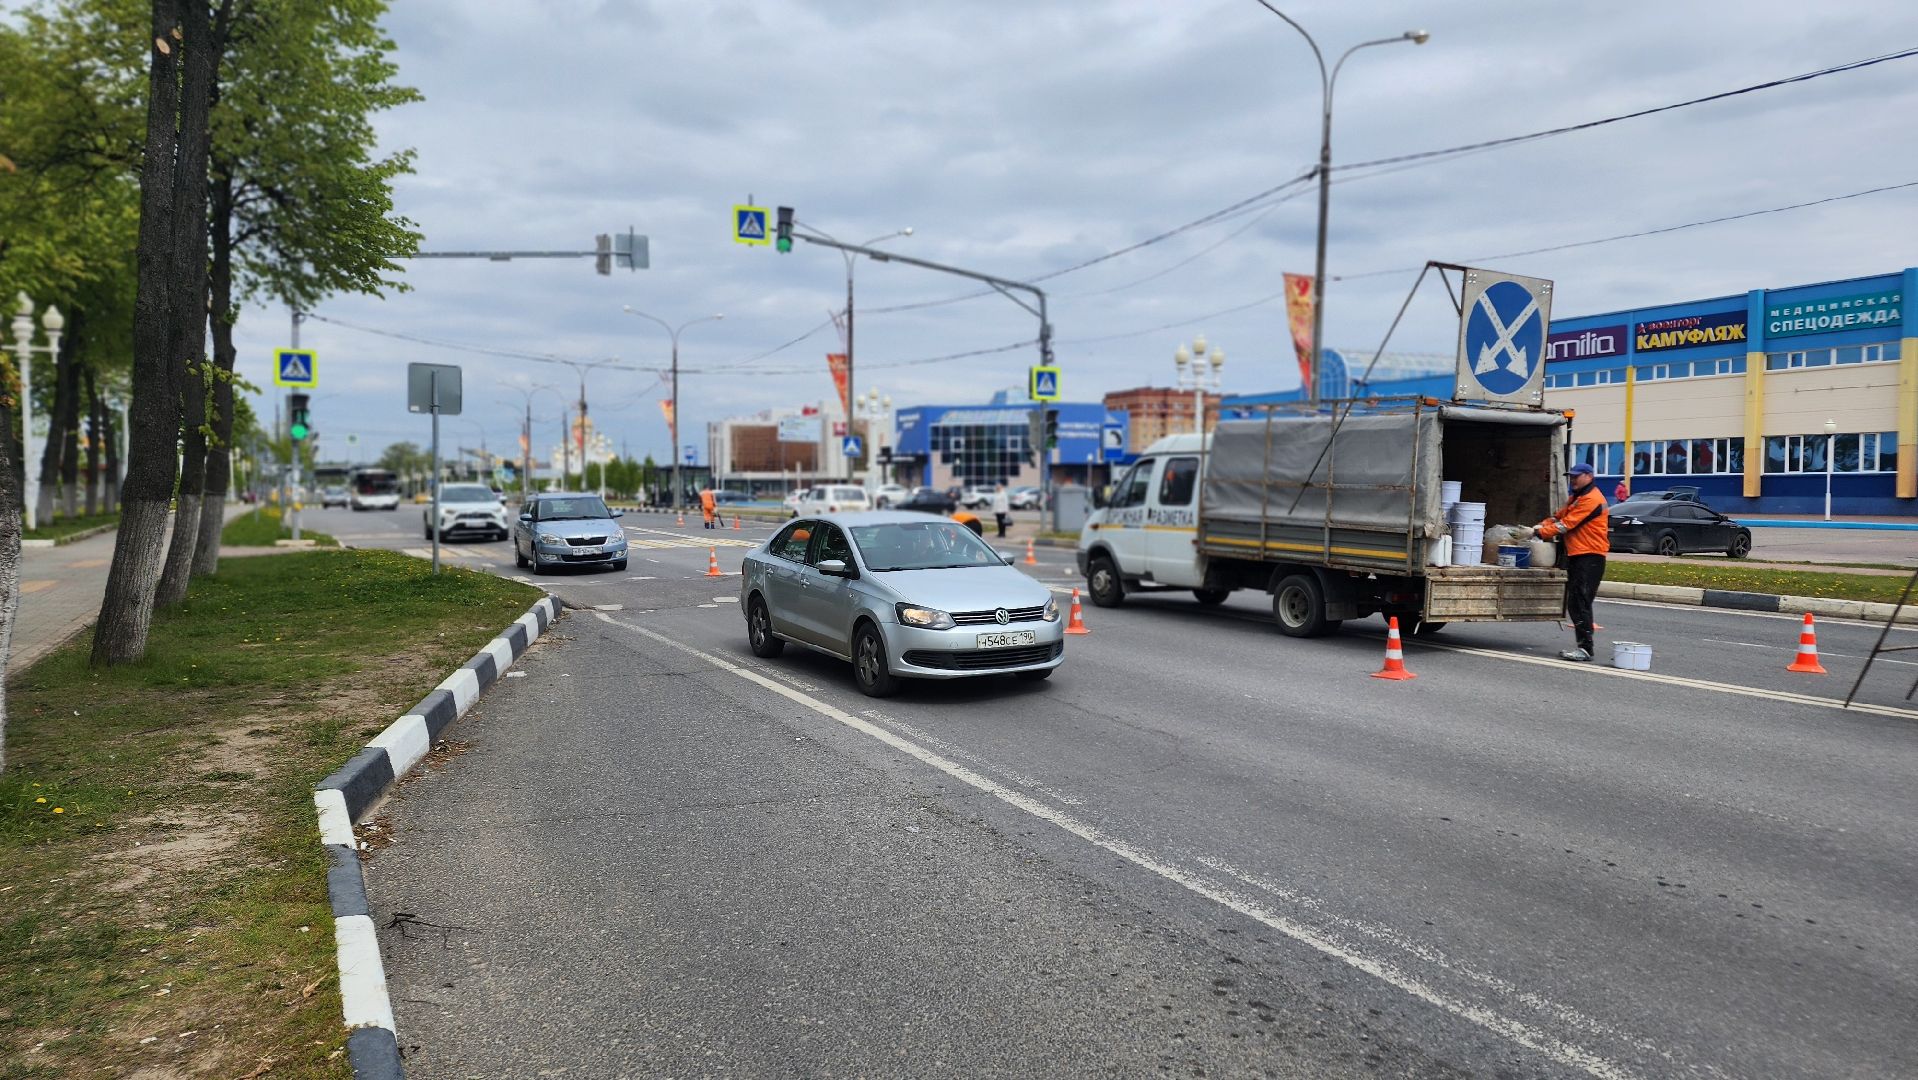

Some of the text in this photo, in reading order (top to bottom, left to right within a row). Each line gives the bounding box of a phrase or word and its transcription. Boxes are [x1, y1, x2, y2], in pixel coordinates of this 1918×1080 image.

[1770, 295, 1900, 317] МЕДИЦИНСКАЯ
[1770, 309, 1900, 333] СПЕЦОДЕЖДА
[1637, 323, 1746, 350] КАМУФЛЯЖ
